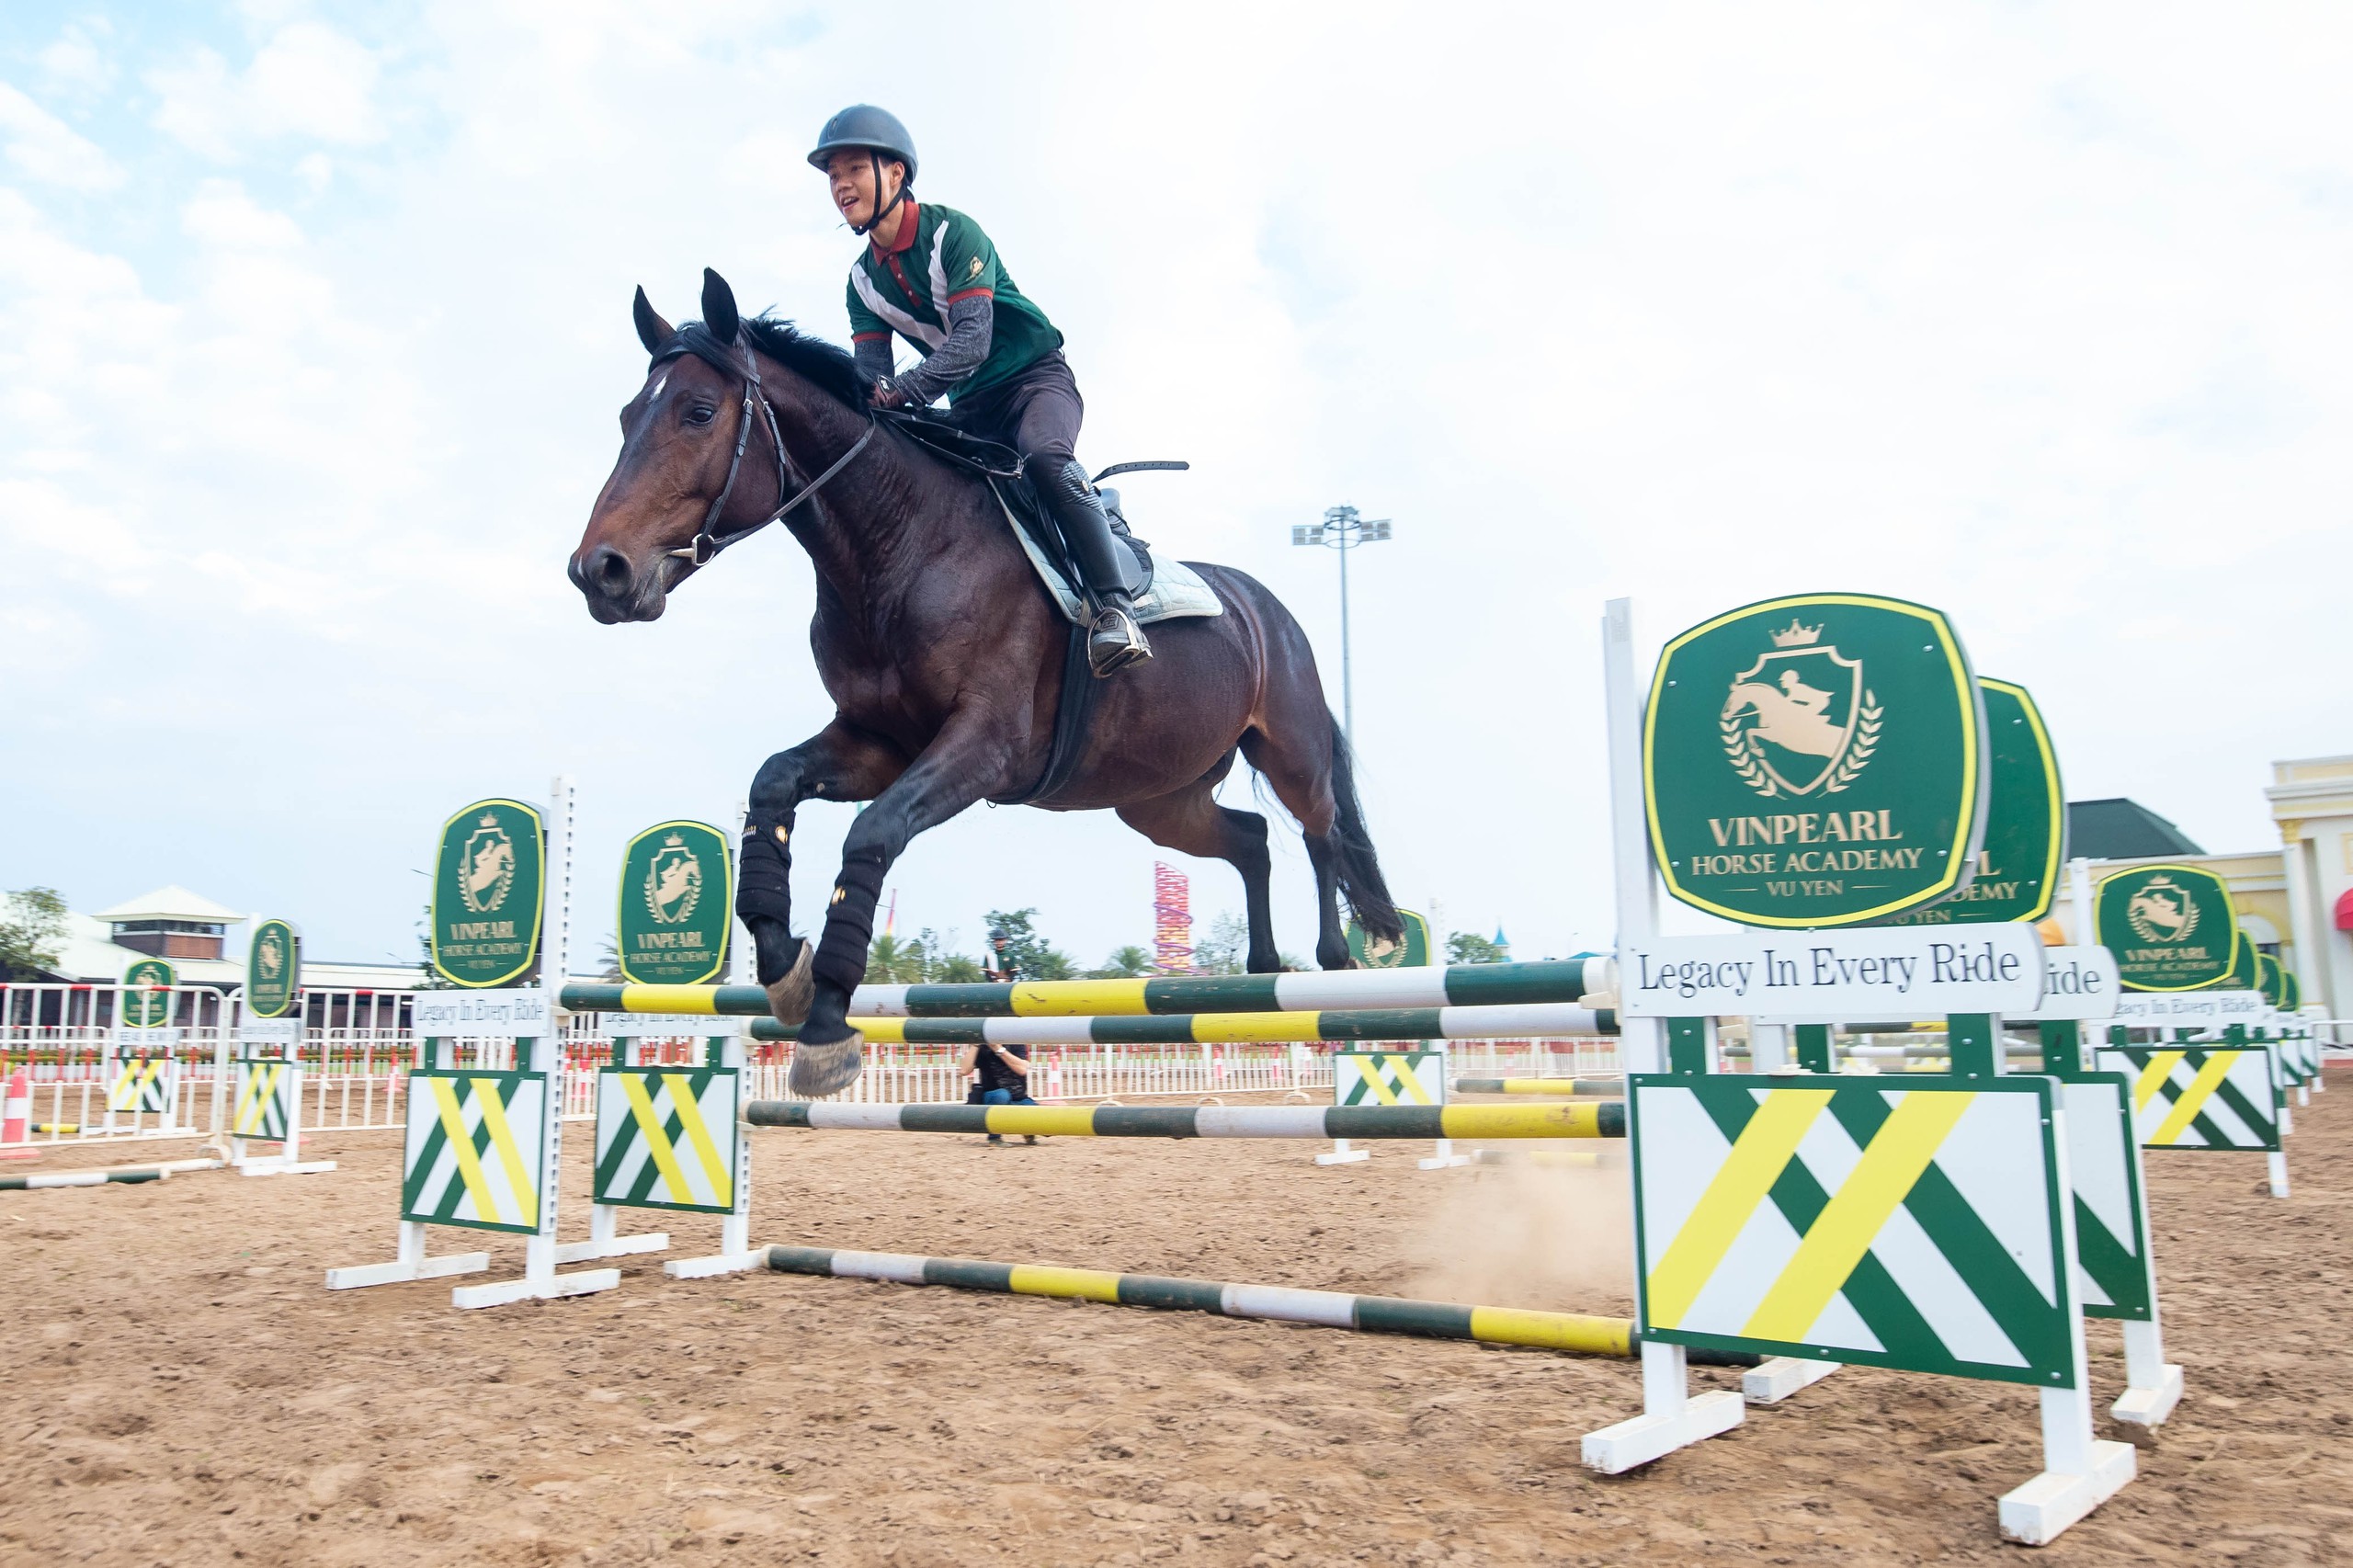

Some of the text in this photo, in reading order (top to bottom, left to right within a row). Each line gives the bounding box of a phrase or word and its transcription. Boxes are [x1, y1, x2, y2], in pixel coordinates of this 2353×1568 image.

[1707, 809, 1904, 847] VINPEARL
[1690, 847, 1926, 876] HORSE ACADEMY
[1765, 880, 1844, 897] VU YEN
[450, 920, 517, 940] VINPEARL
[637, 931, 706, 949] VINPEARL
[1637, 941, 2022, 1000] Legacy In Every Ride
[2044, 960, 2103, 995] ide
